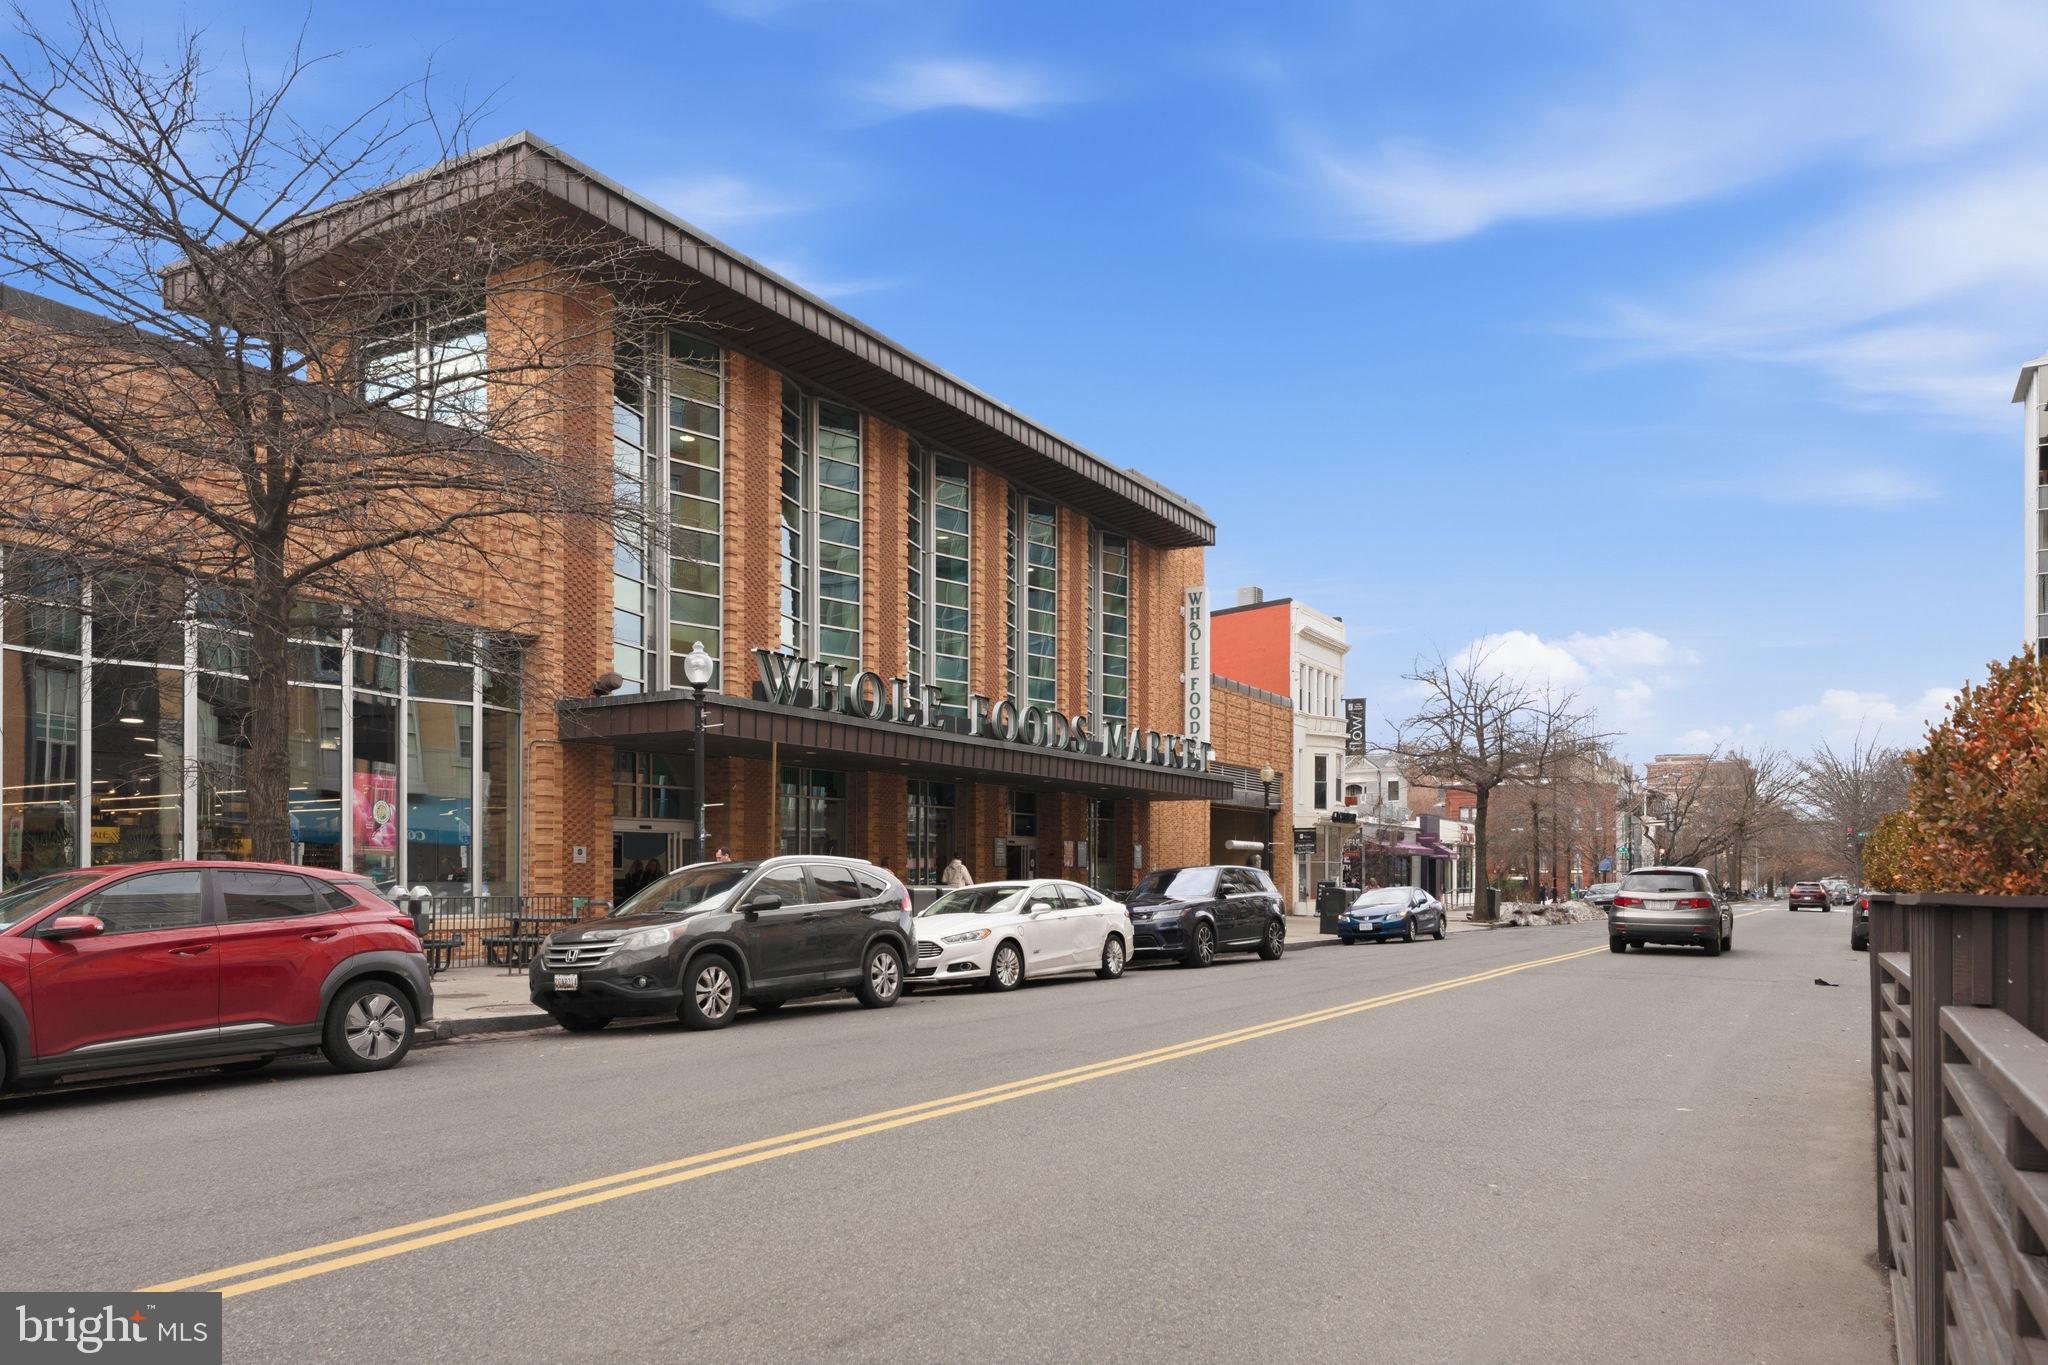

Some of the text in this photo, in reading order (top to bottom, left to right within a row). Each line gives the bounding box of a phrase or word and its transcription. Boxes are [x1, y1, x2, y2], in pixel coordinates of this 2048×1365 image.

[1187, 591, 1203, 670] WHOLE
[750, 647, 1214, 773] WHOLE FOODS MARKET
[1349, 715, 1363, 751] flow
[91, 831, 110, 839] ALE
